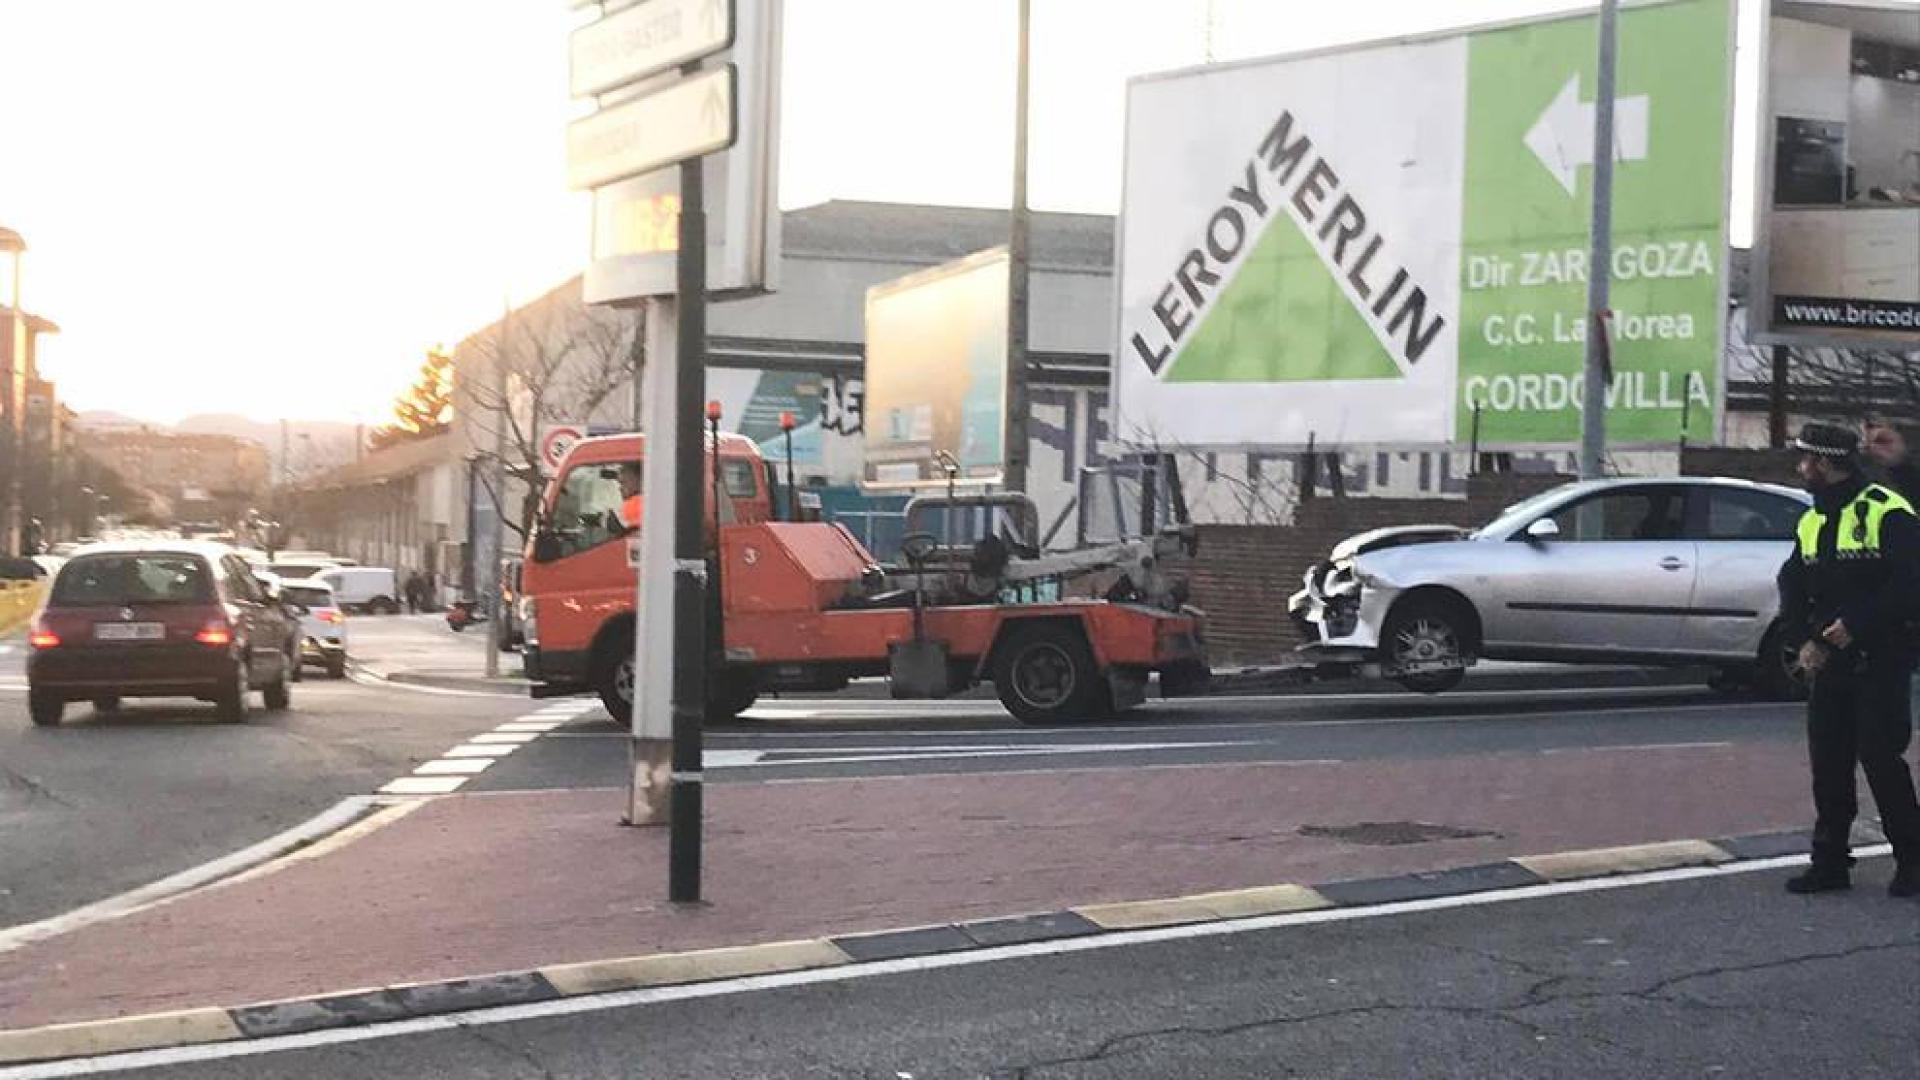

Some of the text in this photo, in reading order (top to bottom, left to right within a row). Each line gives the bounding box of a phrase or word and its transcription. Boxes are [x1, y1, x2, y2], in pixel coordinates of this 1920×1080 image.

[1131, 109, 1445, 375] LEROY MERLIN
[1469, 241, 1713, 288] Dir ZARGOZA
[1484, 313, 1544, 345] C.C.
[1553, 313, 1585, 343] La
